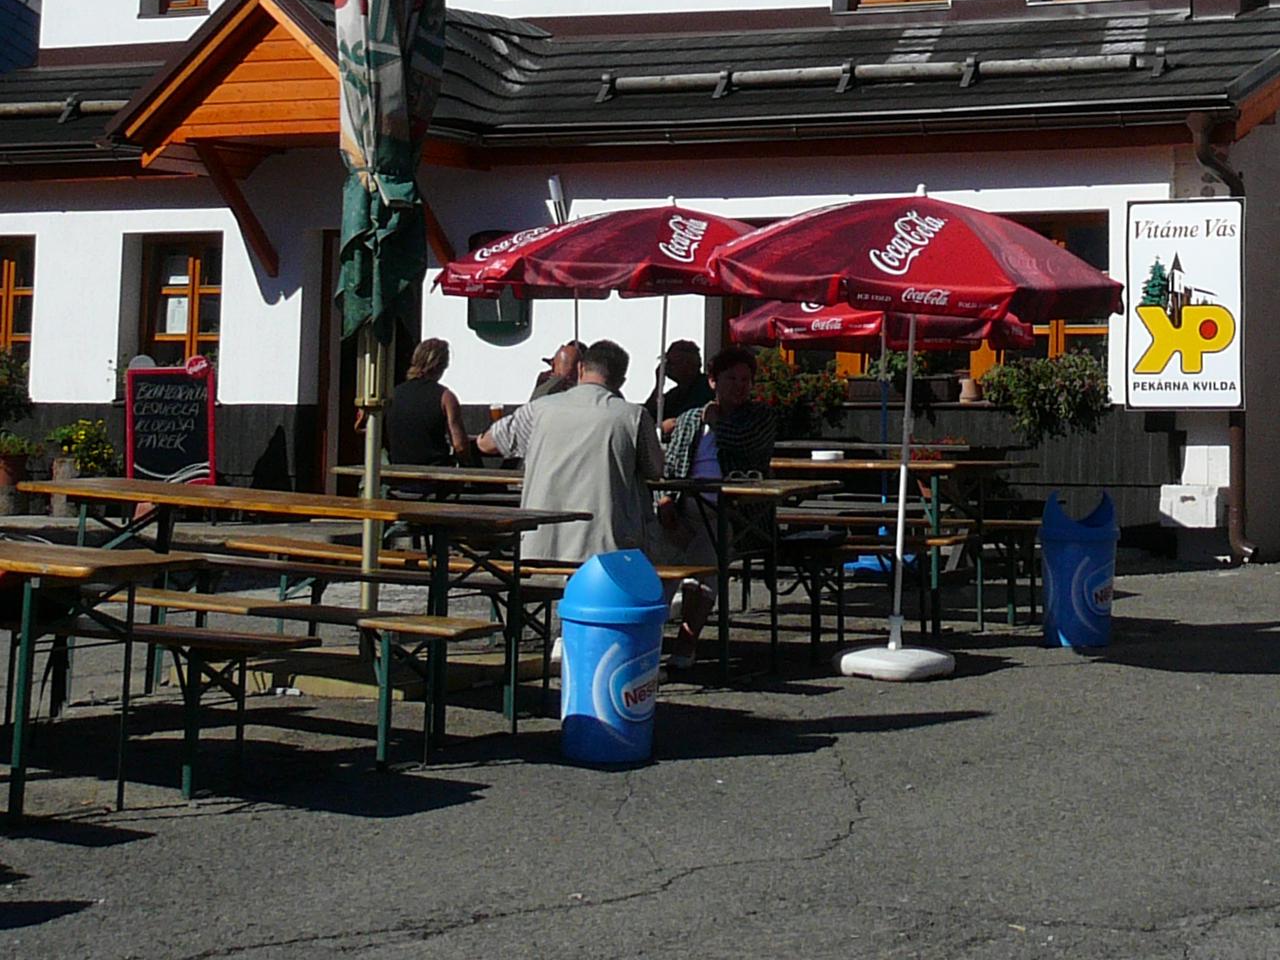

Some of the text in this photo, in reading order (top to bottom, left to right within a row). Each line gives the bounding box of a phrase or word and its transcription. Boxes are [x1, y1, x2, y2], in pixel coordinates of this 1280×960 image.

[659, 214, 708, 263] Coca-Cola
[1134, 218, 1237, 239] Vítáme Vás
[869, 209, 946, 276] Coca-Cola
[901, 287, 951, 306] Coca-Cola
[1132, 379, 1237, 392] PEKÁRNA KVILDA
